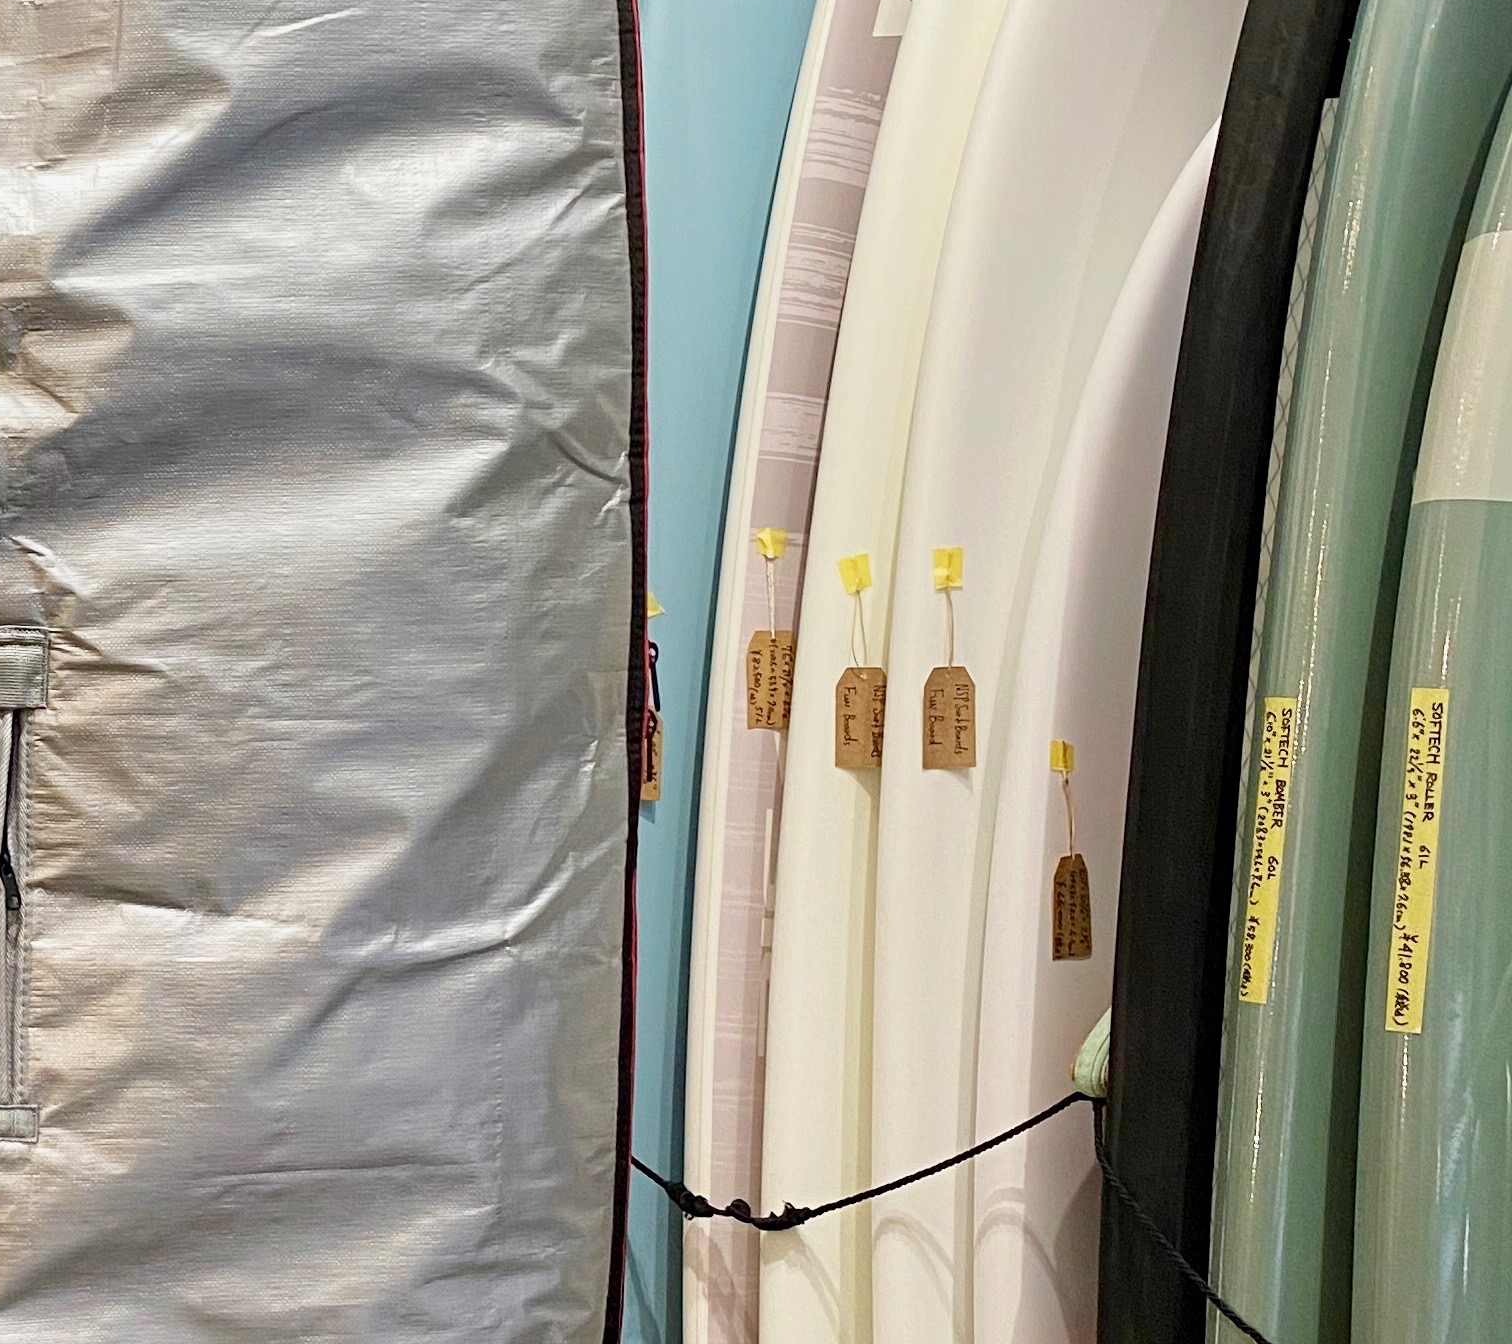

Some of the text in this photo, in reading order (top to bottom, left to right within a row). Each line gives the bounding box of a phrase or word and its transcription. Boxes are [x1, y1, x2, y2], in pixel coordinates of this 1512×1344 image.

[1276, 707, 1294, 769] SOFTECH
[1425, 701, 1445, 765] SOFTECH
[1269, 779, 1288, 831] BOMBER
[1421, 771, 1438, 823] ROLLER
